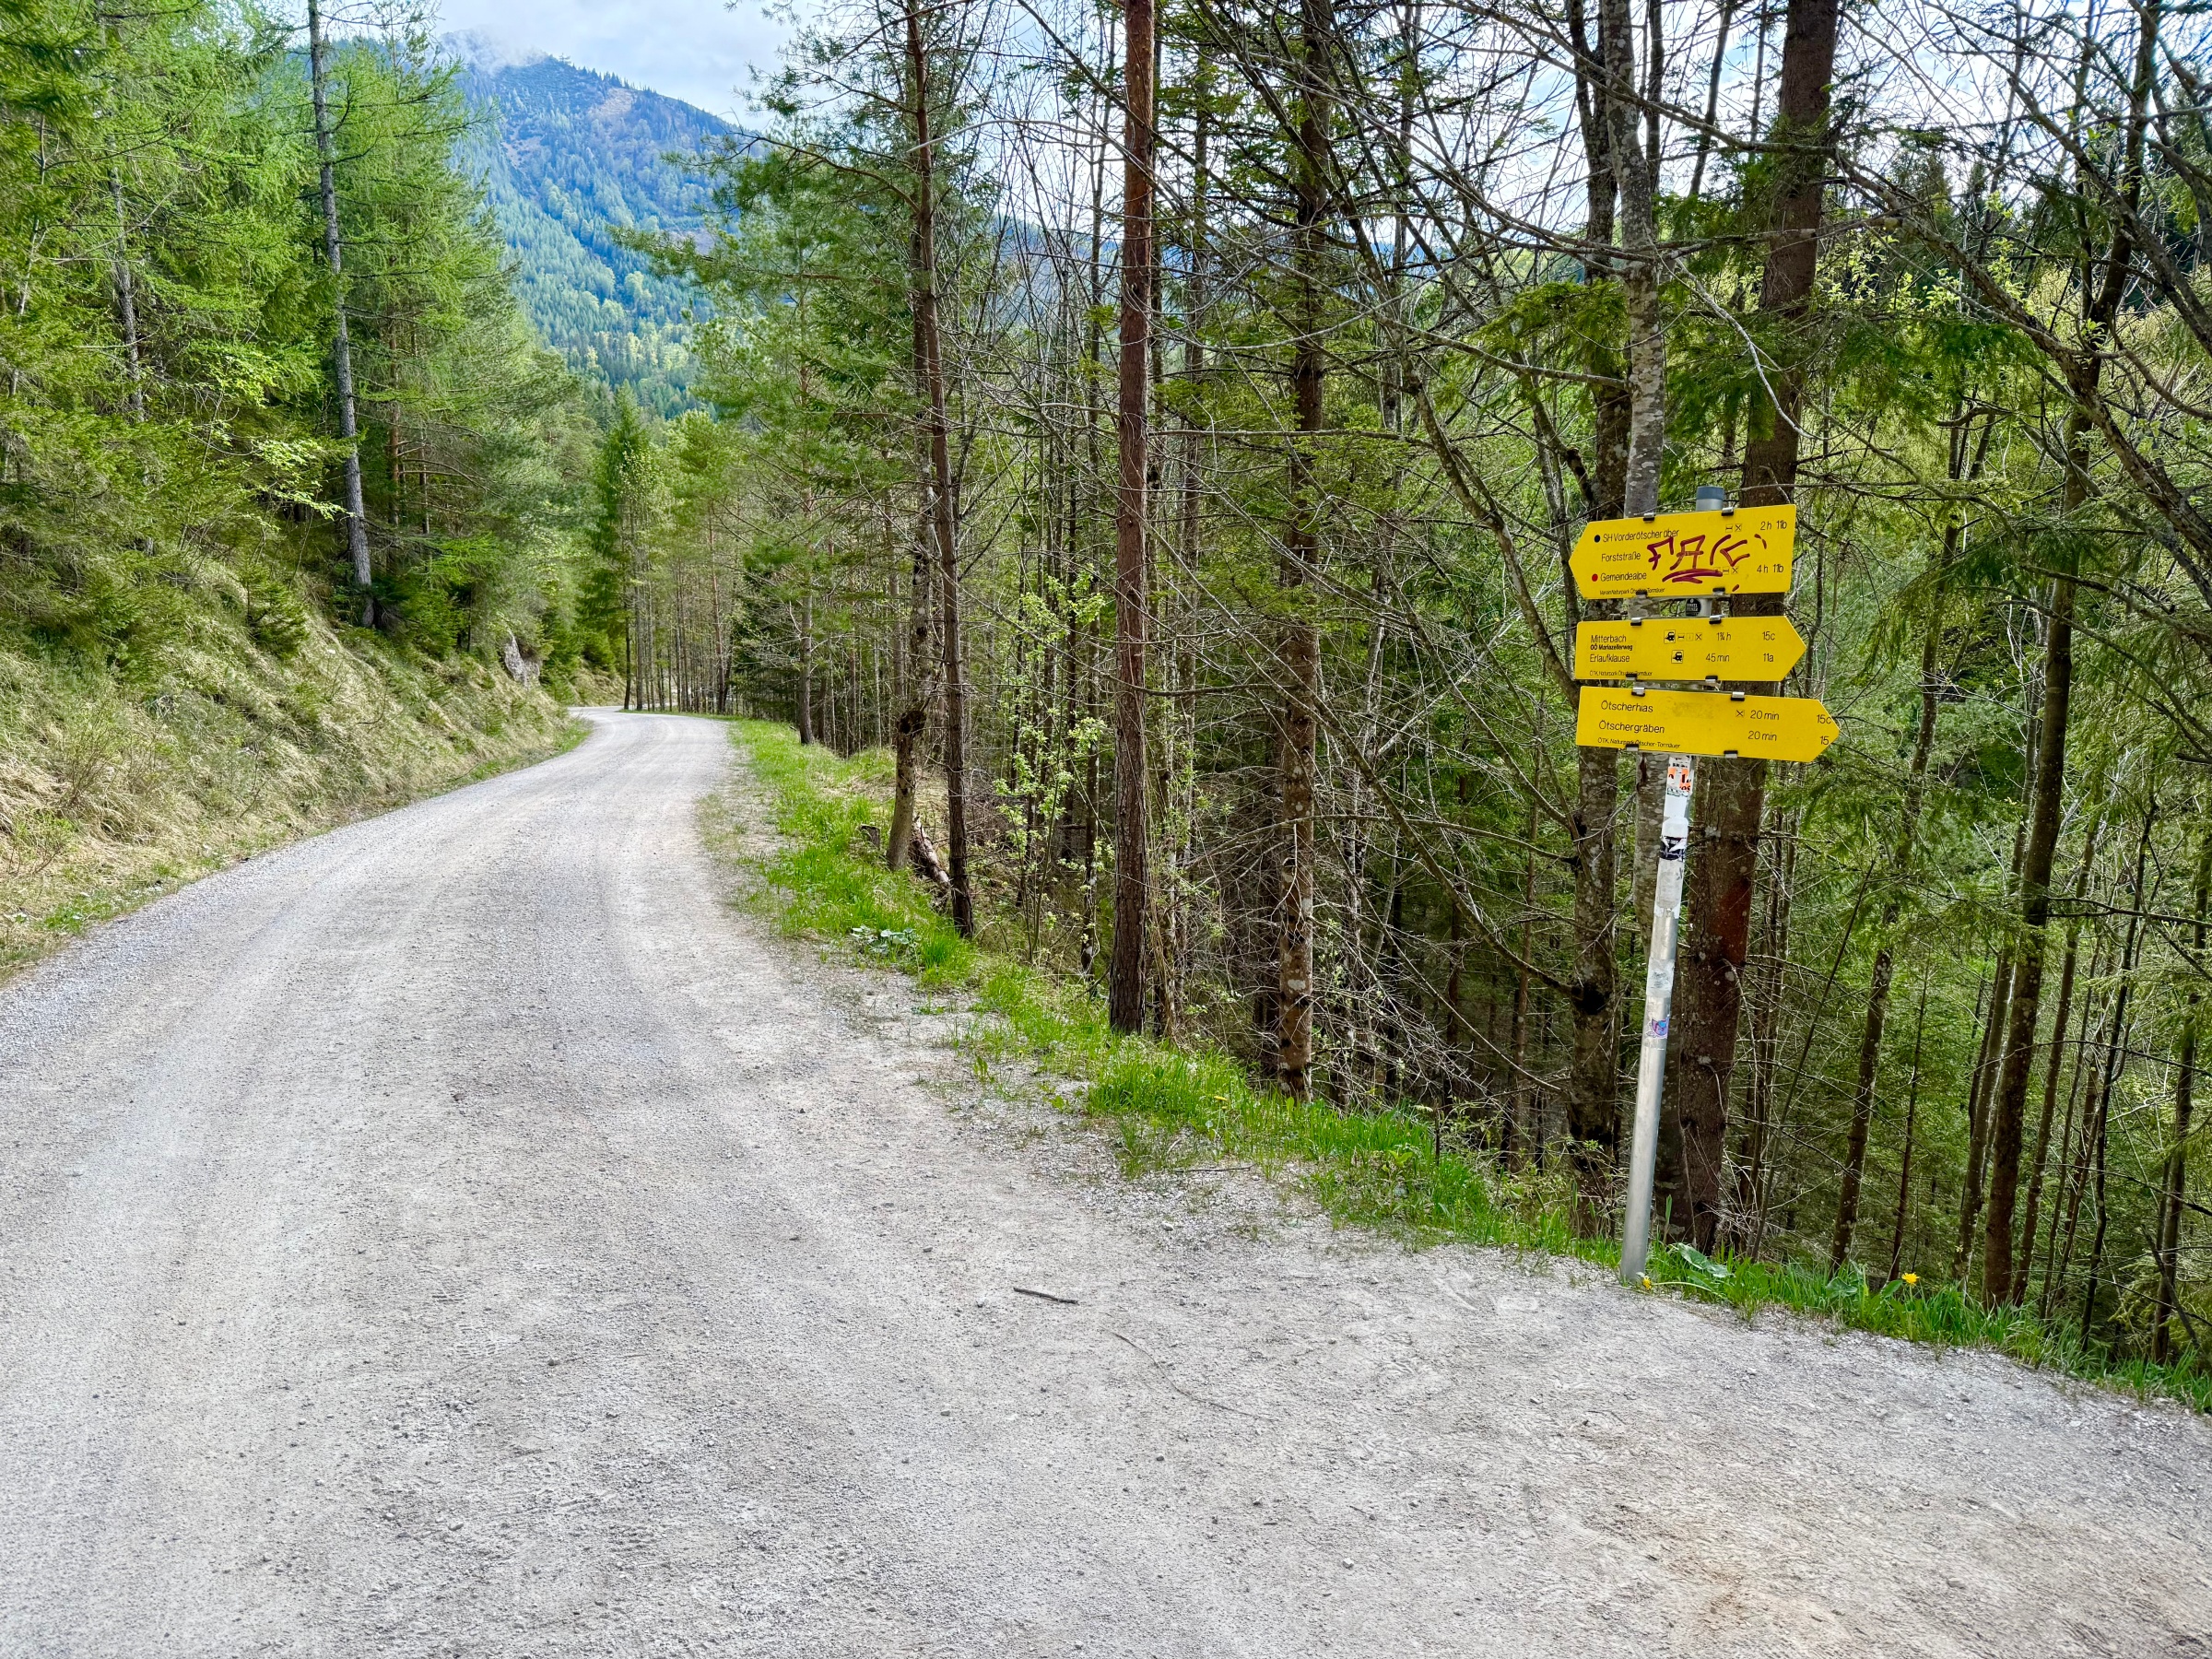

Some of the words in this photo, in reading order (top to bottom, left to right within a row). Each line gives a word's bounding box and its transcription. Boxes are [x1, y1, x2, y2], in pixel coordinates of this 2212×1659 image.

[1776, 520, 1787, 529] 11b
[1613, 530, 1663, 542] Vorderötscher
[1601, 551, 1641, 562] Forststraße
[1773, 563, 1784, 573] 11b
[1600, 571, 1647, 582] Gemeindealpe
[1590, 634, 1627, 643] Mitterbach
[1762, 631, 1775, 641] 15c
[1598, 643, 1633, 652] Mariazellerweg
[1590, 653, 1630, 663] Erlaufklause
[1705, 653, 1716, 662] 45
[1716, 653, 1730, 662] min
[1763, 653, 1774, 662] 11a
[1601, 700, 1653, 712] Ötscherhias
[1750, 710, 1762, 719] 20
[1763, 711, 1780, 721] min
[1817, 713, 1832, 724] 15c
[1598, 720, 1665, 734] Ötschergräben
[1747, 730, 1760, 740] 20
[1761, 732, 1777, 741] min
[1820, 735, 1830, 746] 15
